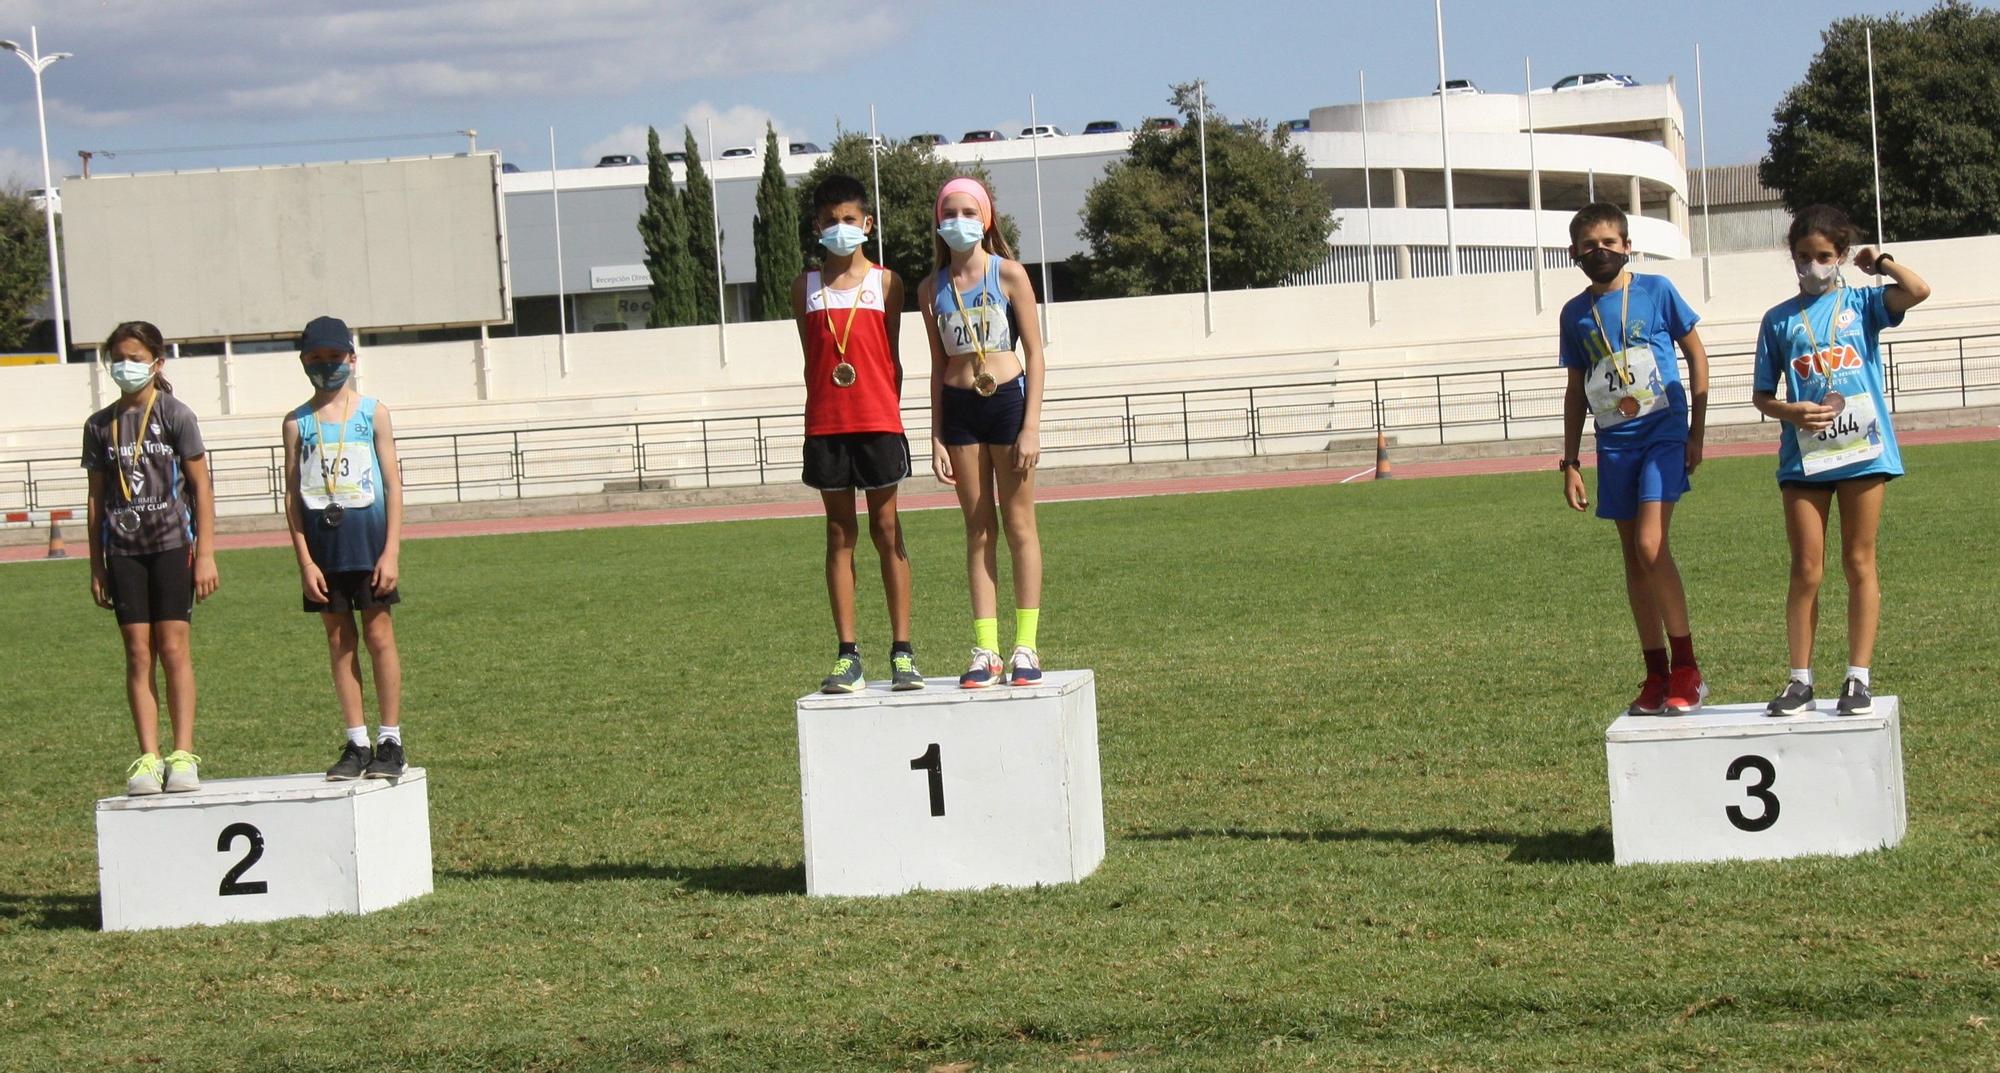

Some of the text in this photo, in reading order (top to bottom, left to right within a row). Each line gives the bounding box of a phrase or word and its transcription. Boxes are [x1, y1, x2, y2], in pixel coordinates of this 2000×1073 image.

[618, 299, 651, 313] Rec
[631, 273, 651, 282] Direc
[910, 743, 945, 817] 1
[1725, 755, 1780, 832] 3
[217, 822, 268, 896] 2
